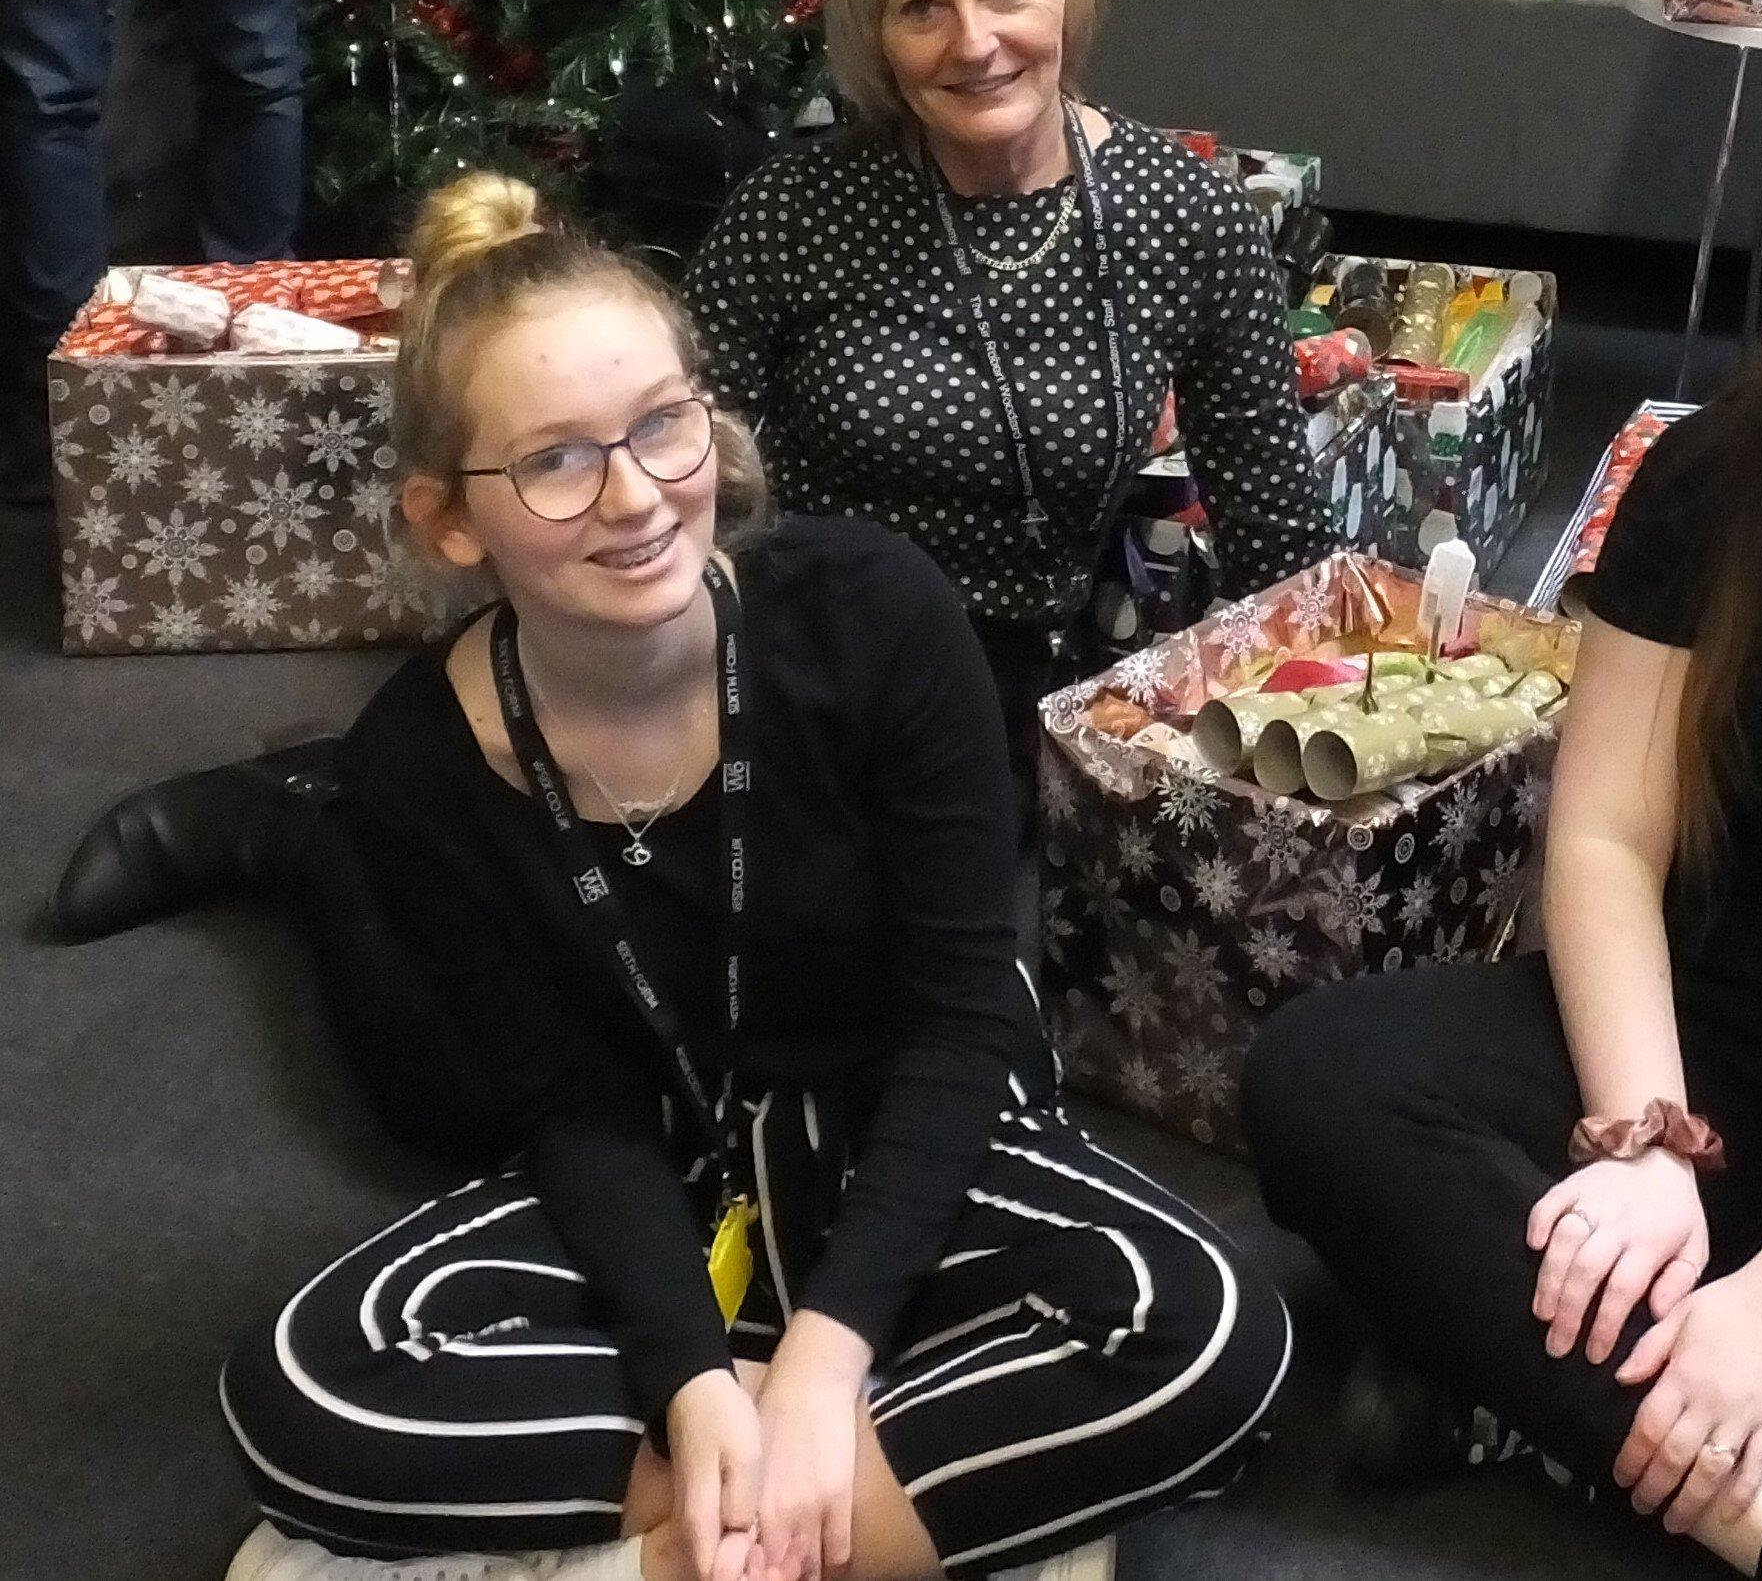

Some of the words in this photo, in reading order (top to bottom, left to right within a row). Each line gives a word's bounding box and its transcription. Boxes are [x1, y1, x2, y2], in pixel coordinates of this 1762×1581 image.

[970, 294, 984, 319] The
[983, 339, 1007, 383] Robert
[999, 382, 1024, 440] Woodard
[1108, 330, 1123, 389] Academy
[725, 760, 750, 793] W6
[574, 867, 610, 905] W6
